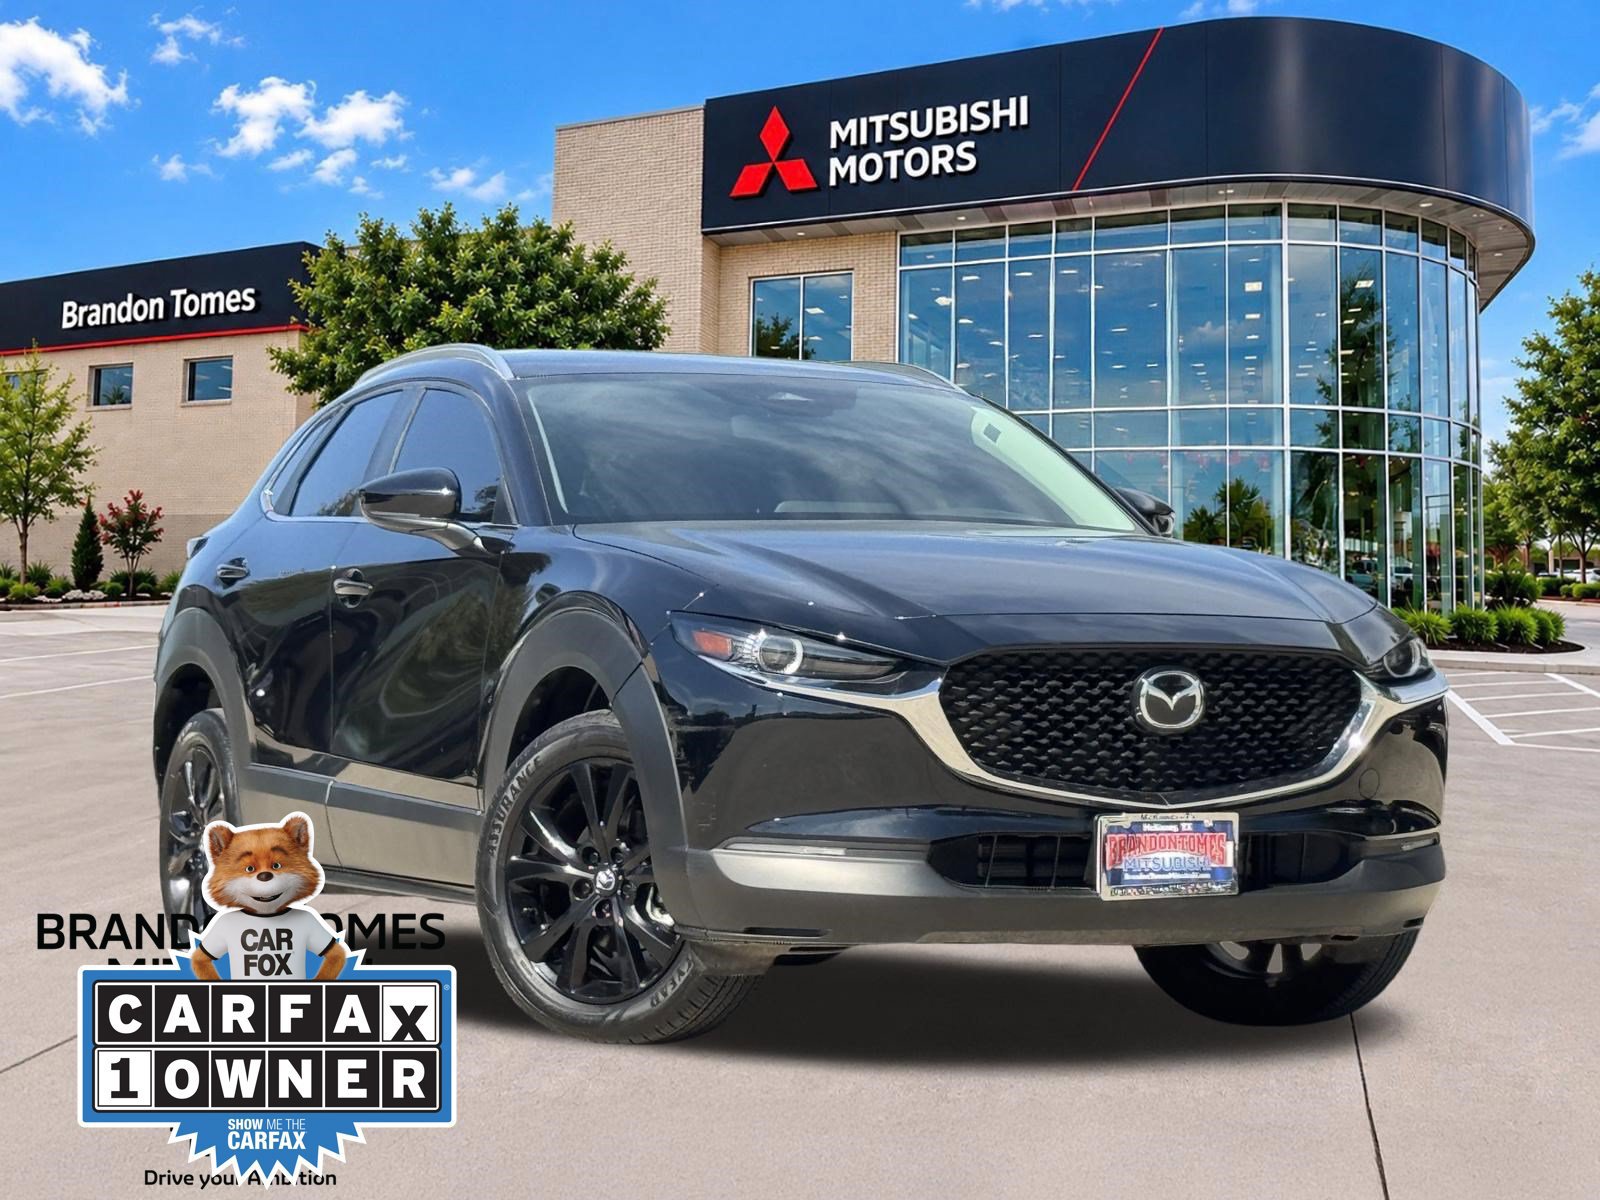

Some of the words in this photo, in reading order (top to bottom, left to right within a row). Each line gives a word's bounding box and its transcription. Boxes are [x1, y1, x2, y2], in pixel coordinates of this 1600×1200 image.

[829, 95, 1029, 149] MITSUBISHI
[829, 140, 977, 187] MOTORS
[61, 293, 164, 330] Brandon
[170, 288, 256, 319] Tomes
[487, 755, 543, 857] ASSURANCE
[1123, 856, 1212, 871] MITSUBISHI
